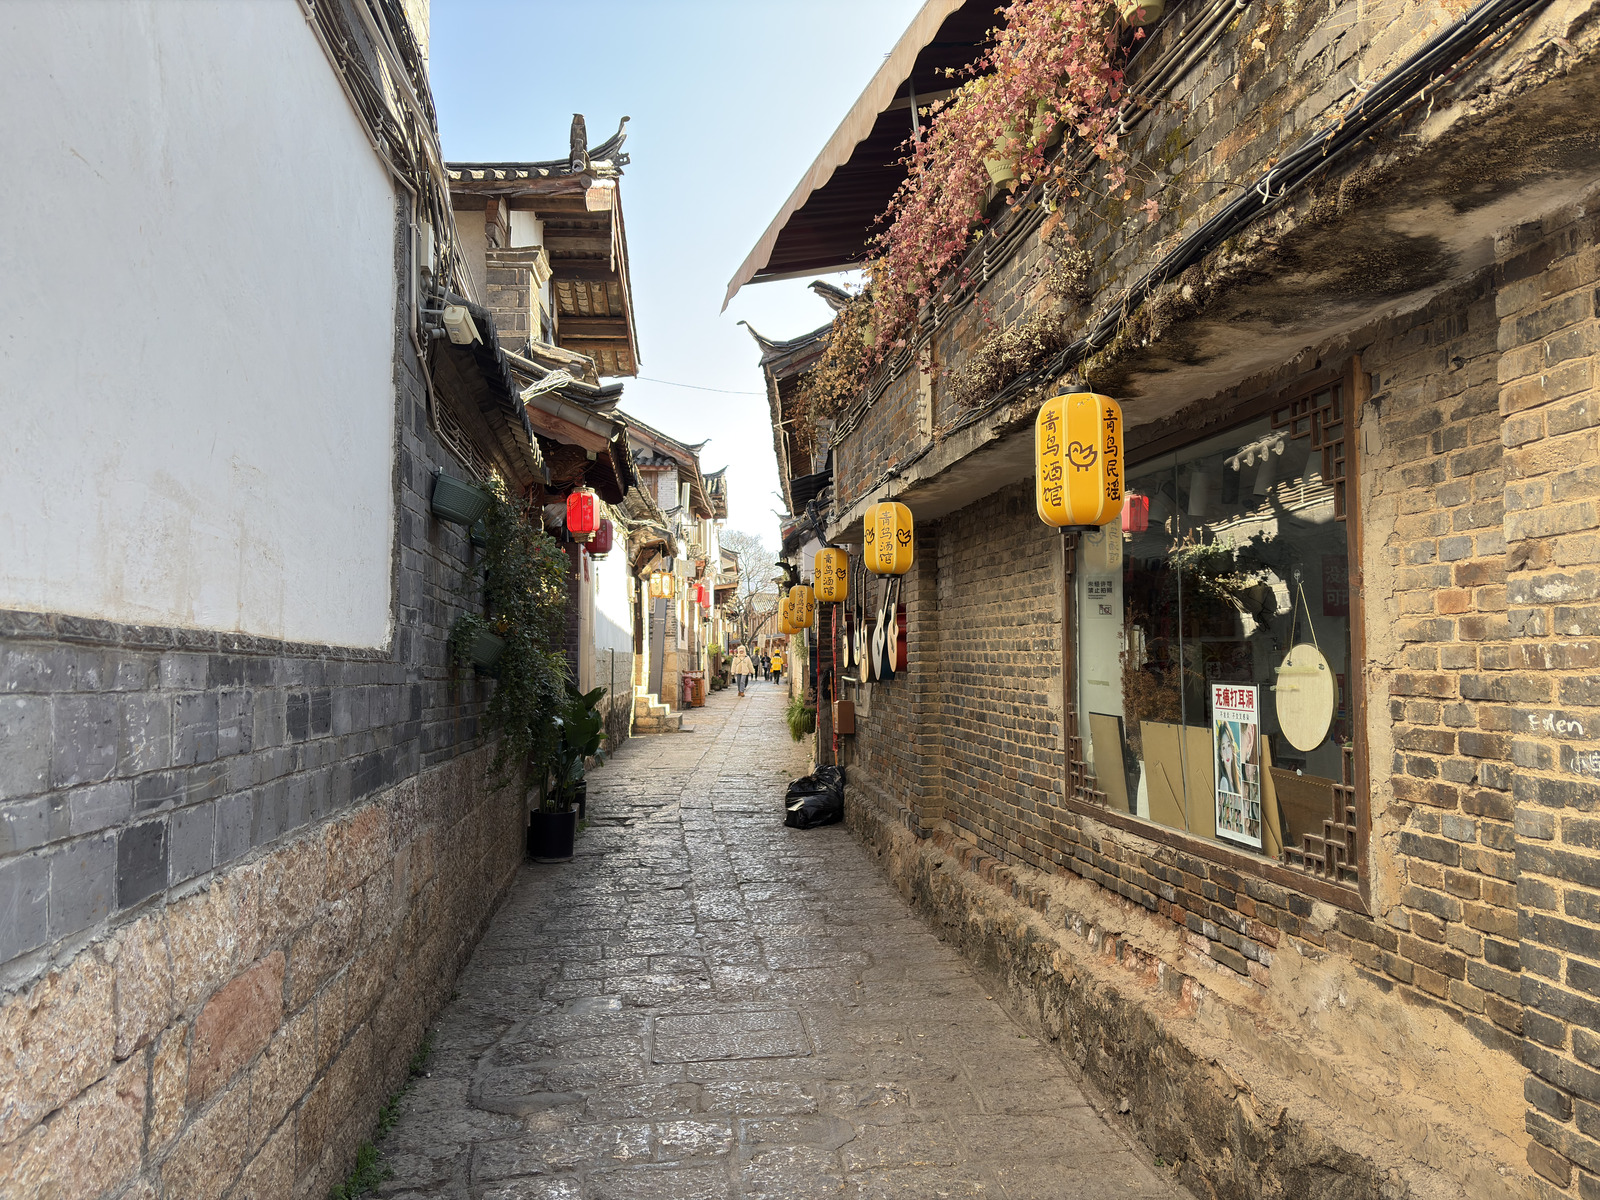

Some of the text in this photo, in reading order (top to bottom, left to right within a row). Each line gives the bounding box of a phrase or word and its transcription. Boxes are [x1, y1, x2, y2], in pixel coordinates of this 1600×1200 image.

[1041, 410, 1062, 507] 青鸟酒馆
[1103, 407, 1121, 501] 青鸟民谣
[880, 511, 893, 564] 青鸟酒馆
[823, 553, 834, 596] 青鸟酒馆
[1215, 688, 1254, 709] 无痛打耳洞
